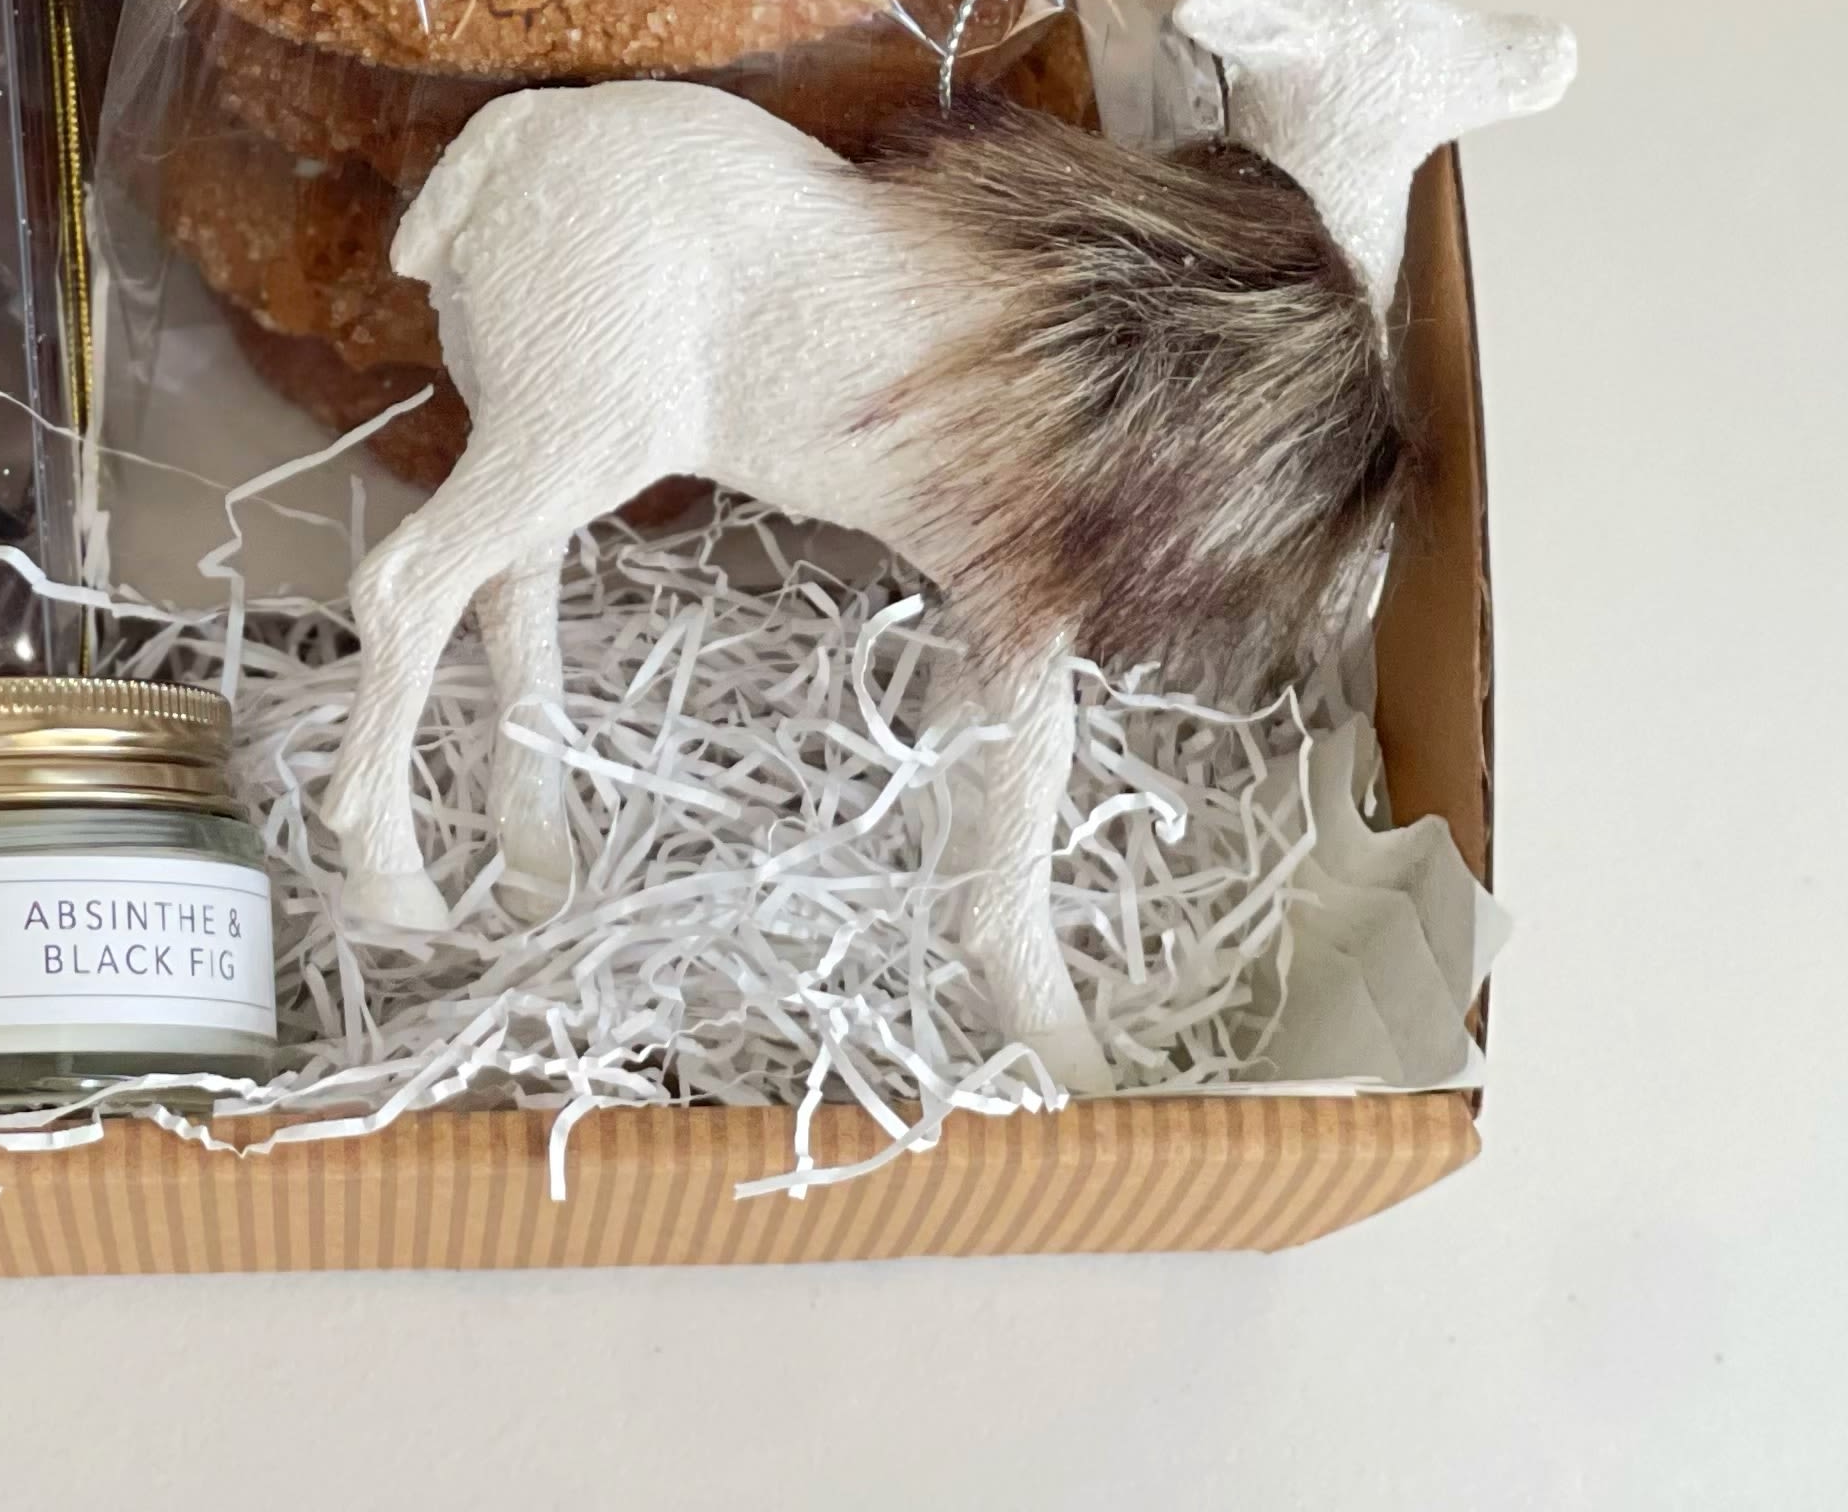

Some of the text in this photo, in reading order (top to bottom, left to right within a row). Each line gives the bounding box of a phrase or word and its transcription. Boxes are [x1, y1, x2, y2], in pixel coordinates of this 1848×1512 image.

[24, 900, 241, 938] ABSINTHE &
[43, 943, 236, 980] BLACK FIG
